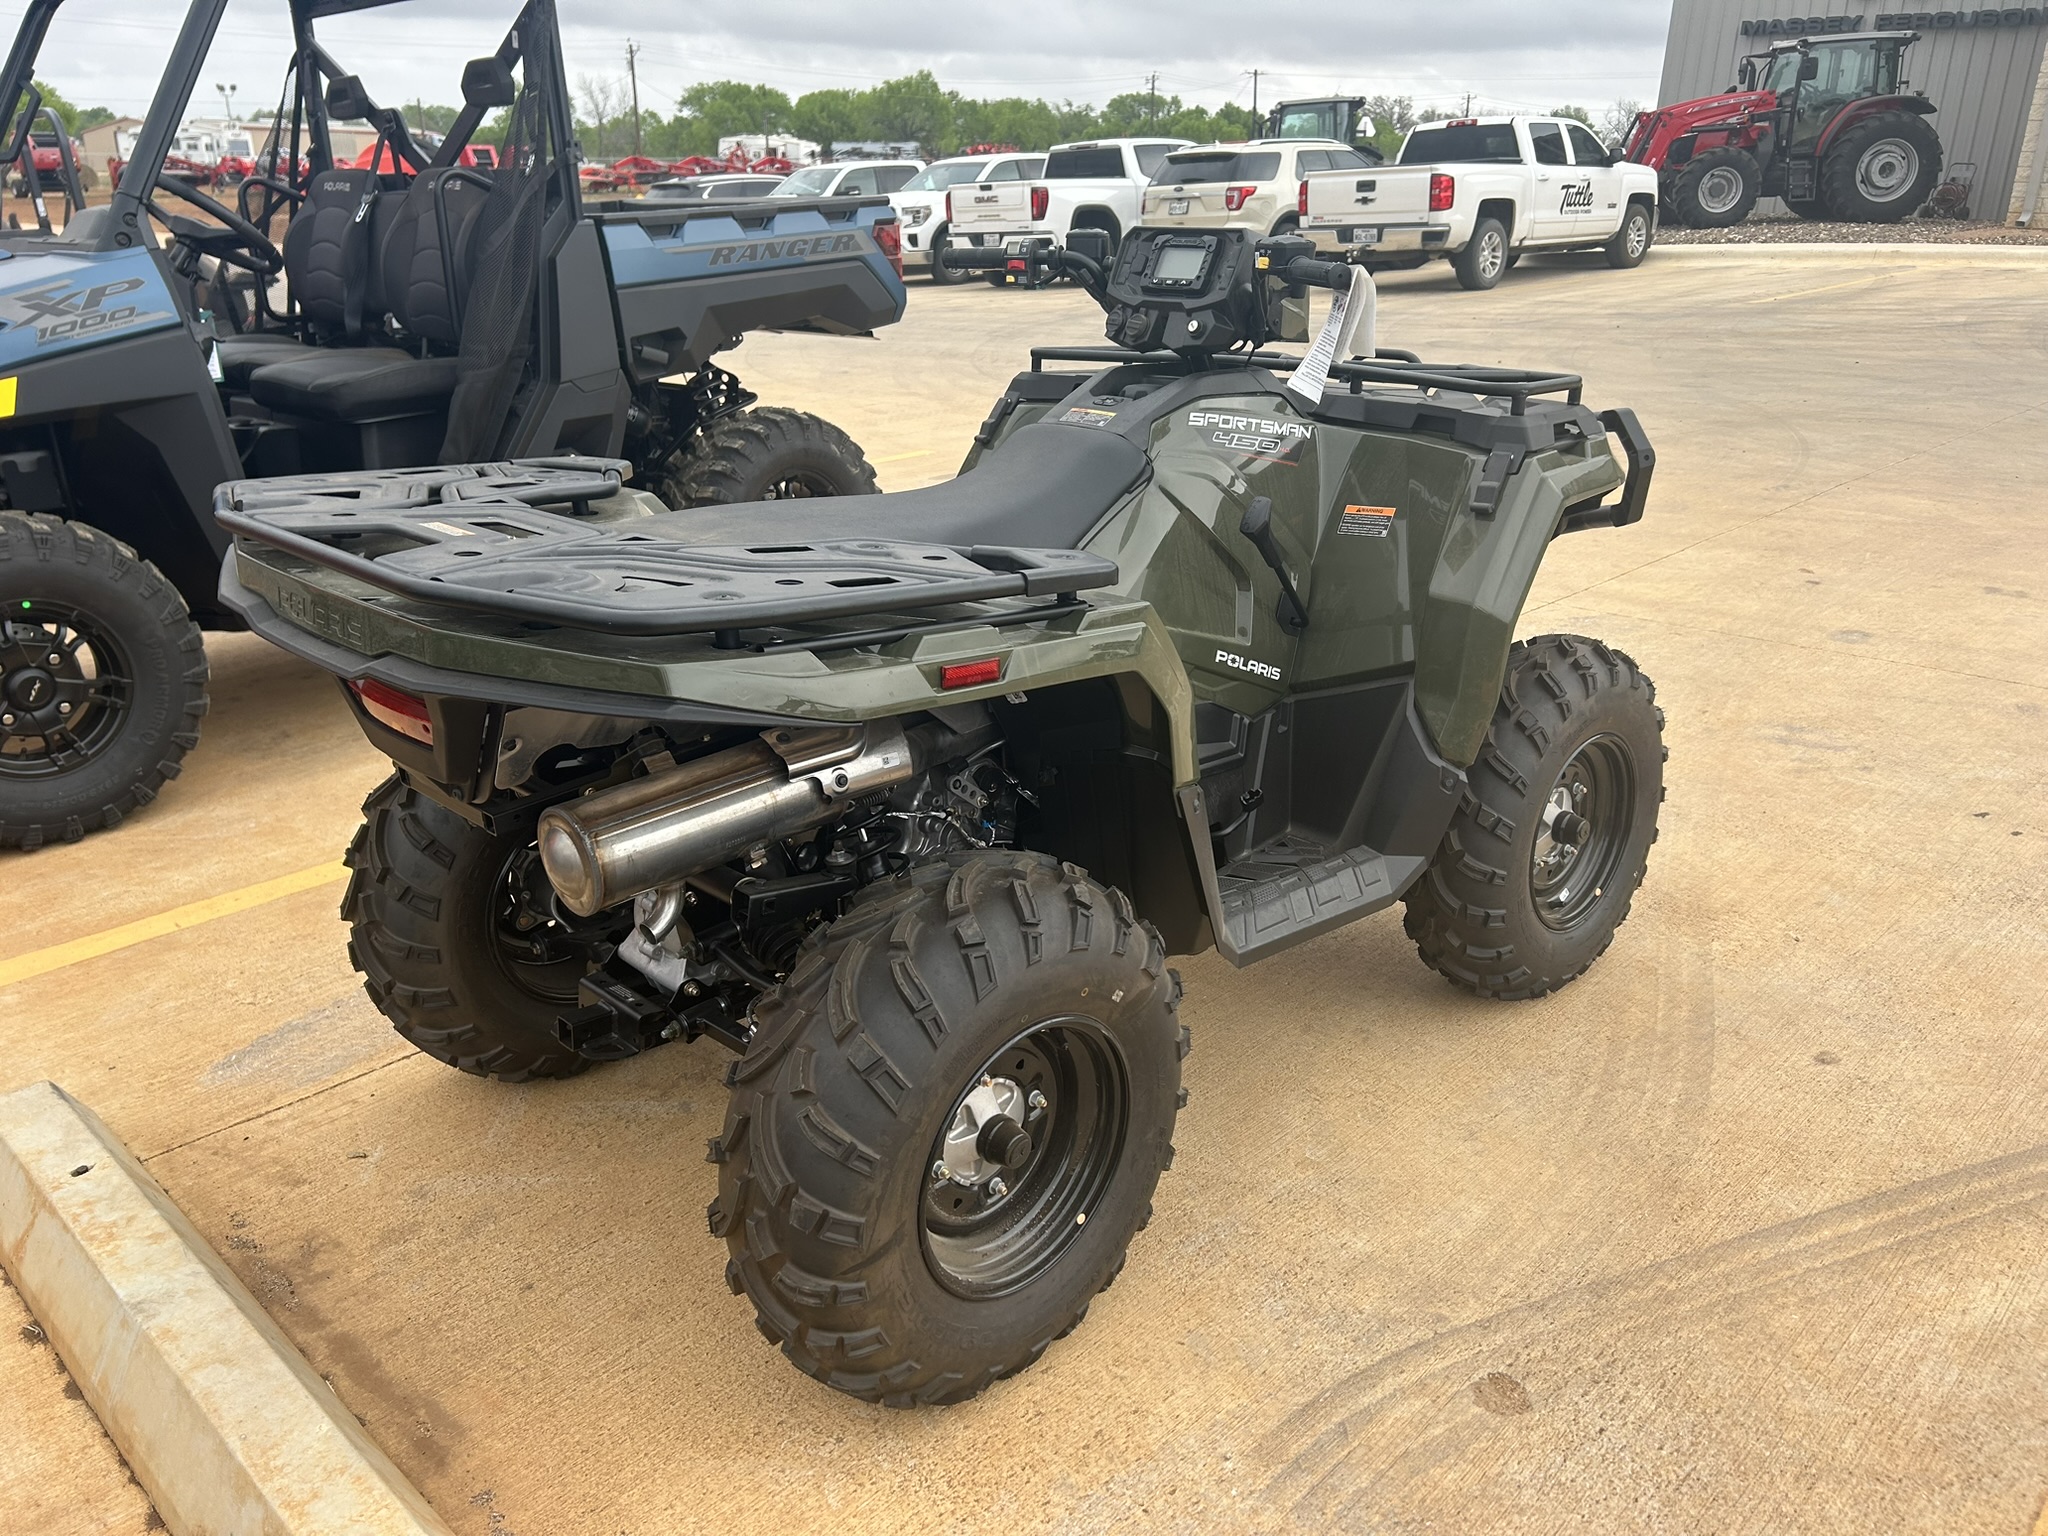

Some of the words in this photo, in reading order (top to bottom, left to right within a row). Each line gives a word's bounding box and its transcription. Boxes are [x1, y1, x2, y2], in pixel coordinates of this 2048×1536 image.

[1740, 15, 1864, 36] MASSEY
[1874, 7, 2048, 31] FERGUSON
[974, 195, 999, 204] GMC
[1560, 181, 1594, 215] Tuttle
[708, 233, 865, 266] RANGER
[9, 276, 146, 333] XP
[38, 305, 137, 341] 1000
[1188, 412, 1313, 440] SPORTSMAN
[1212, 431, 1281, 453] 450
[277, 585, 362, 646] POLARIS
[1215, 649, 1282, 681] POLARIS
